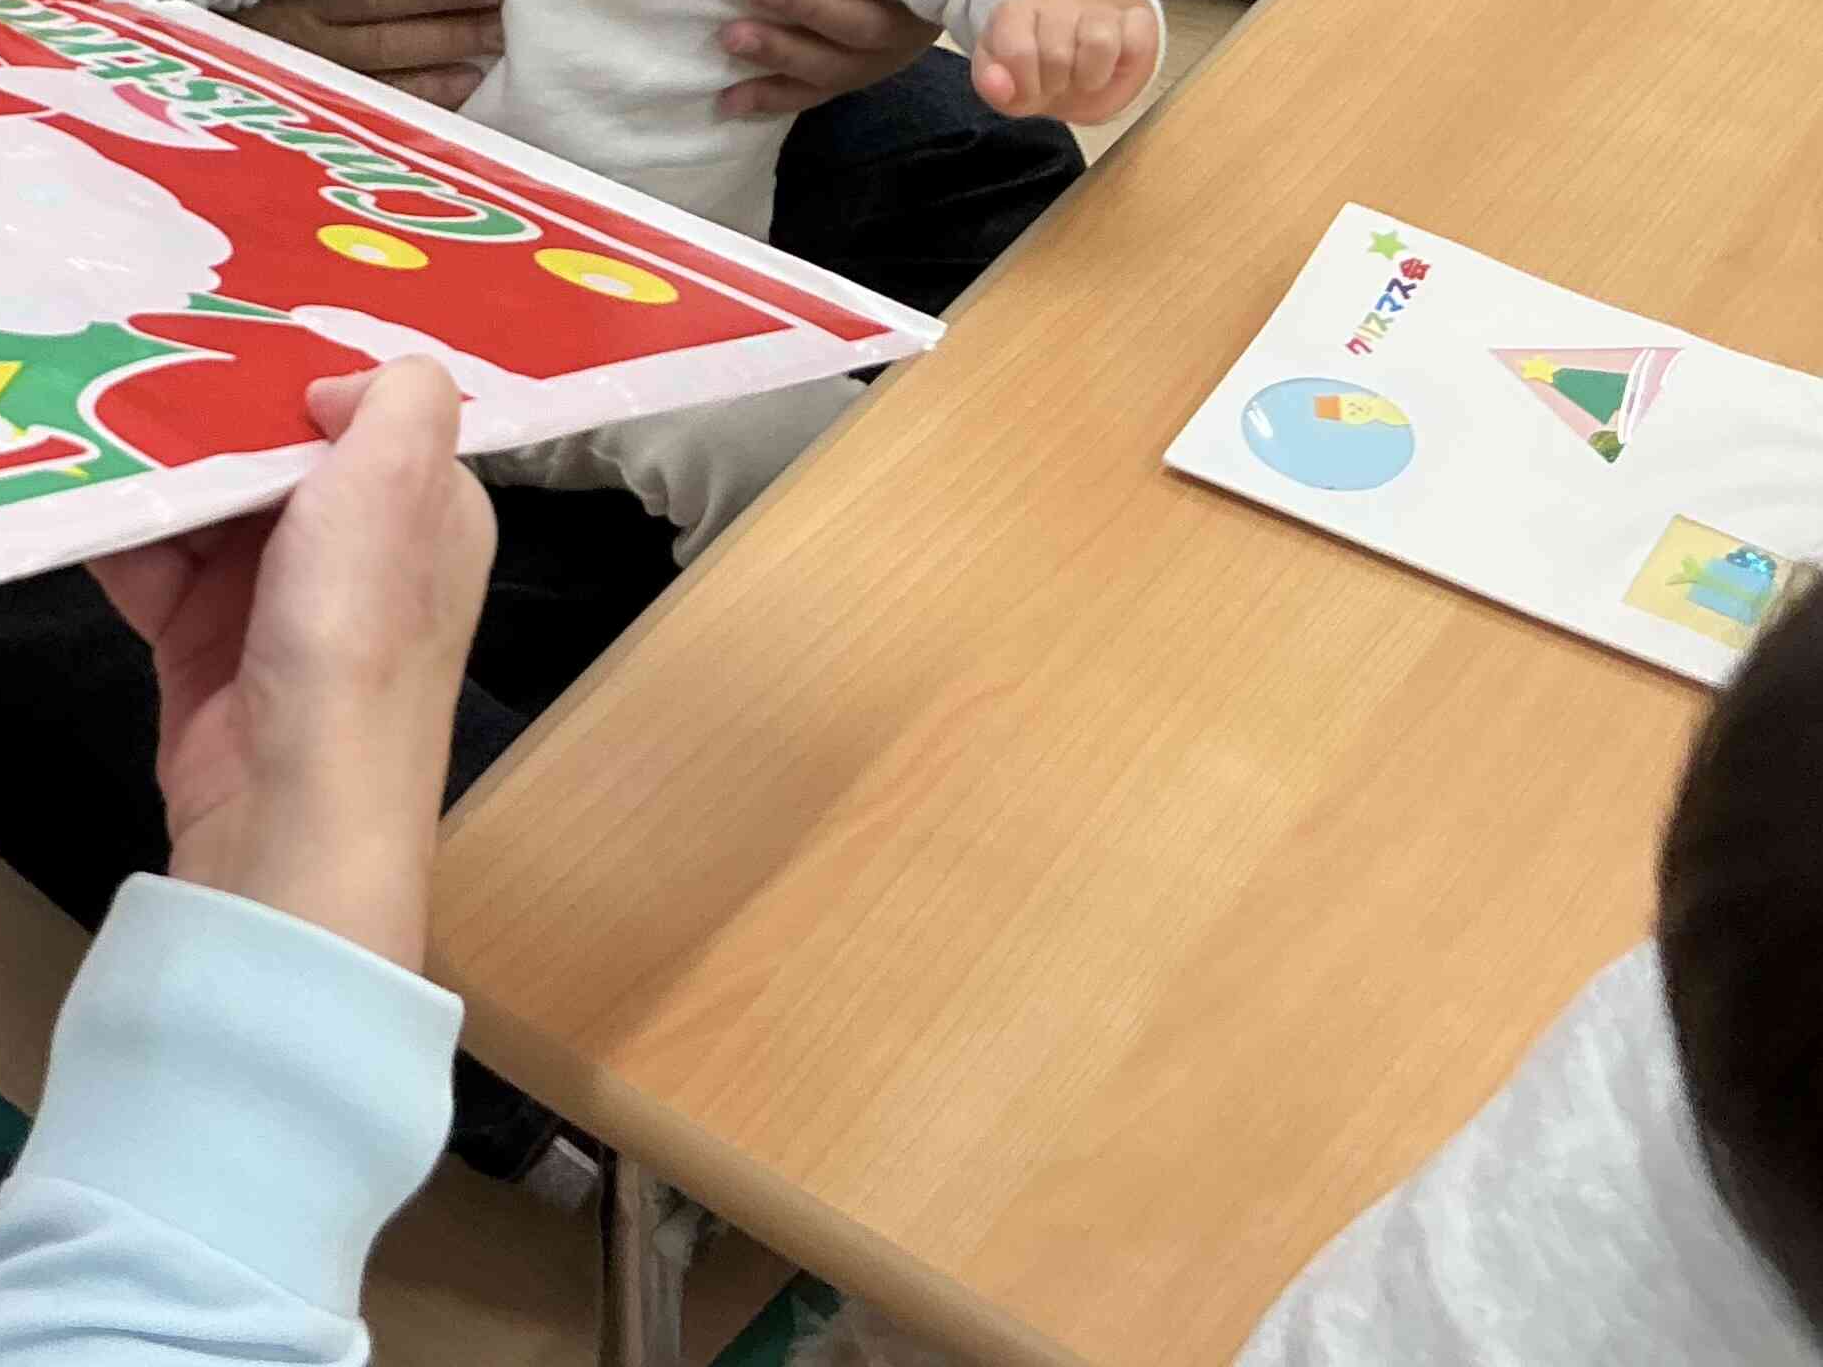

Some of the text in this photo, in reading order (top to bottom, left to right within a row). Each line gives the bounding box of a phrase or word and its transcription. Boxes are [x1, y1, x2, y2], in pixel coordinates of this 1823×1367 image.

[1345, 257, 1431, 355] クリスマス会
